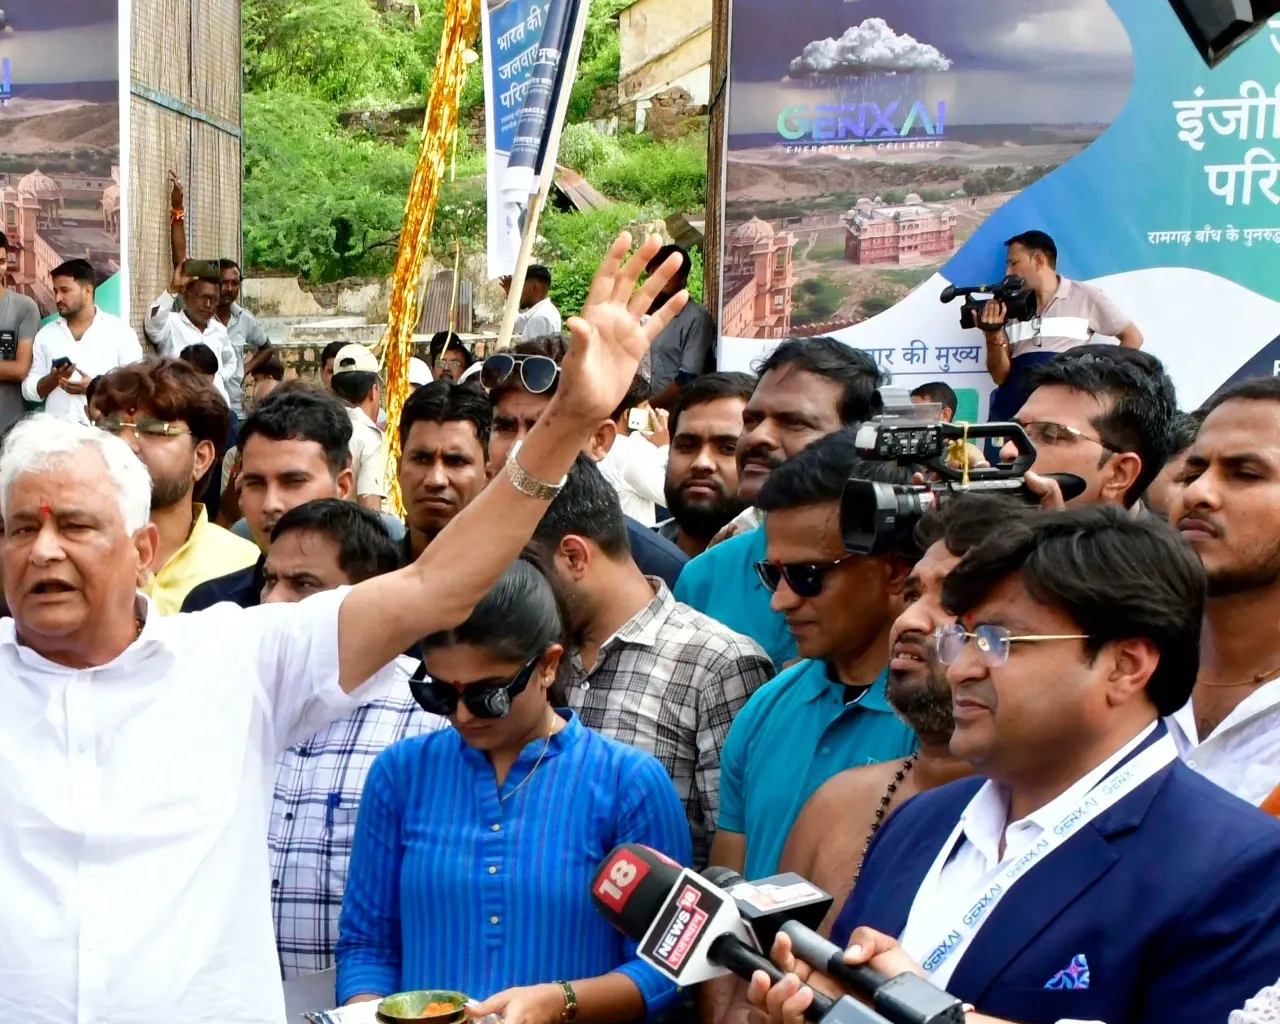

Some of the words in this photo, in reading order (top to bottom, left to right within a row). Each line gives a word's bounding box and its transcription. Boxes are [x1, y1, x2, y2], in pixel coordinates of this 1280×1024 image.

[497, 22, 525, 50] भारत
[527, 5, 541, 31] की
[776, 100, 946, 139] GENXAI
[1147, 230, 1192, 246] रामगढ़
[1225, 224, 1240, 242] के
[901, 339, 929, 365] की
[935, 346, 982, 372] मुख्य
[599, 859, 637, 901] 18
[659, 911, 691, 958] NEWS
[681, 889, 698, 909] 18
[963, 883, 1002, 926] GENXAI
[922, 929, 962, 971] GENXAI
